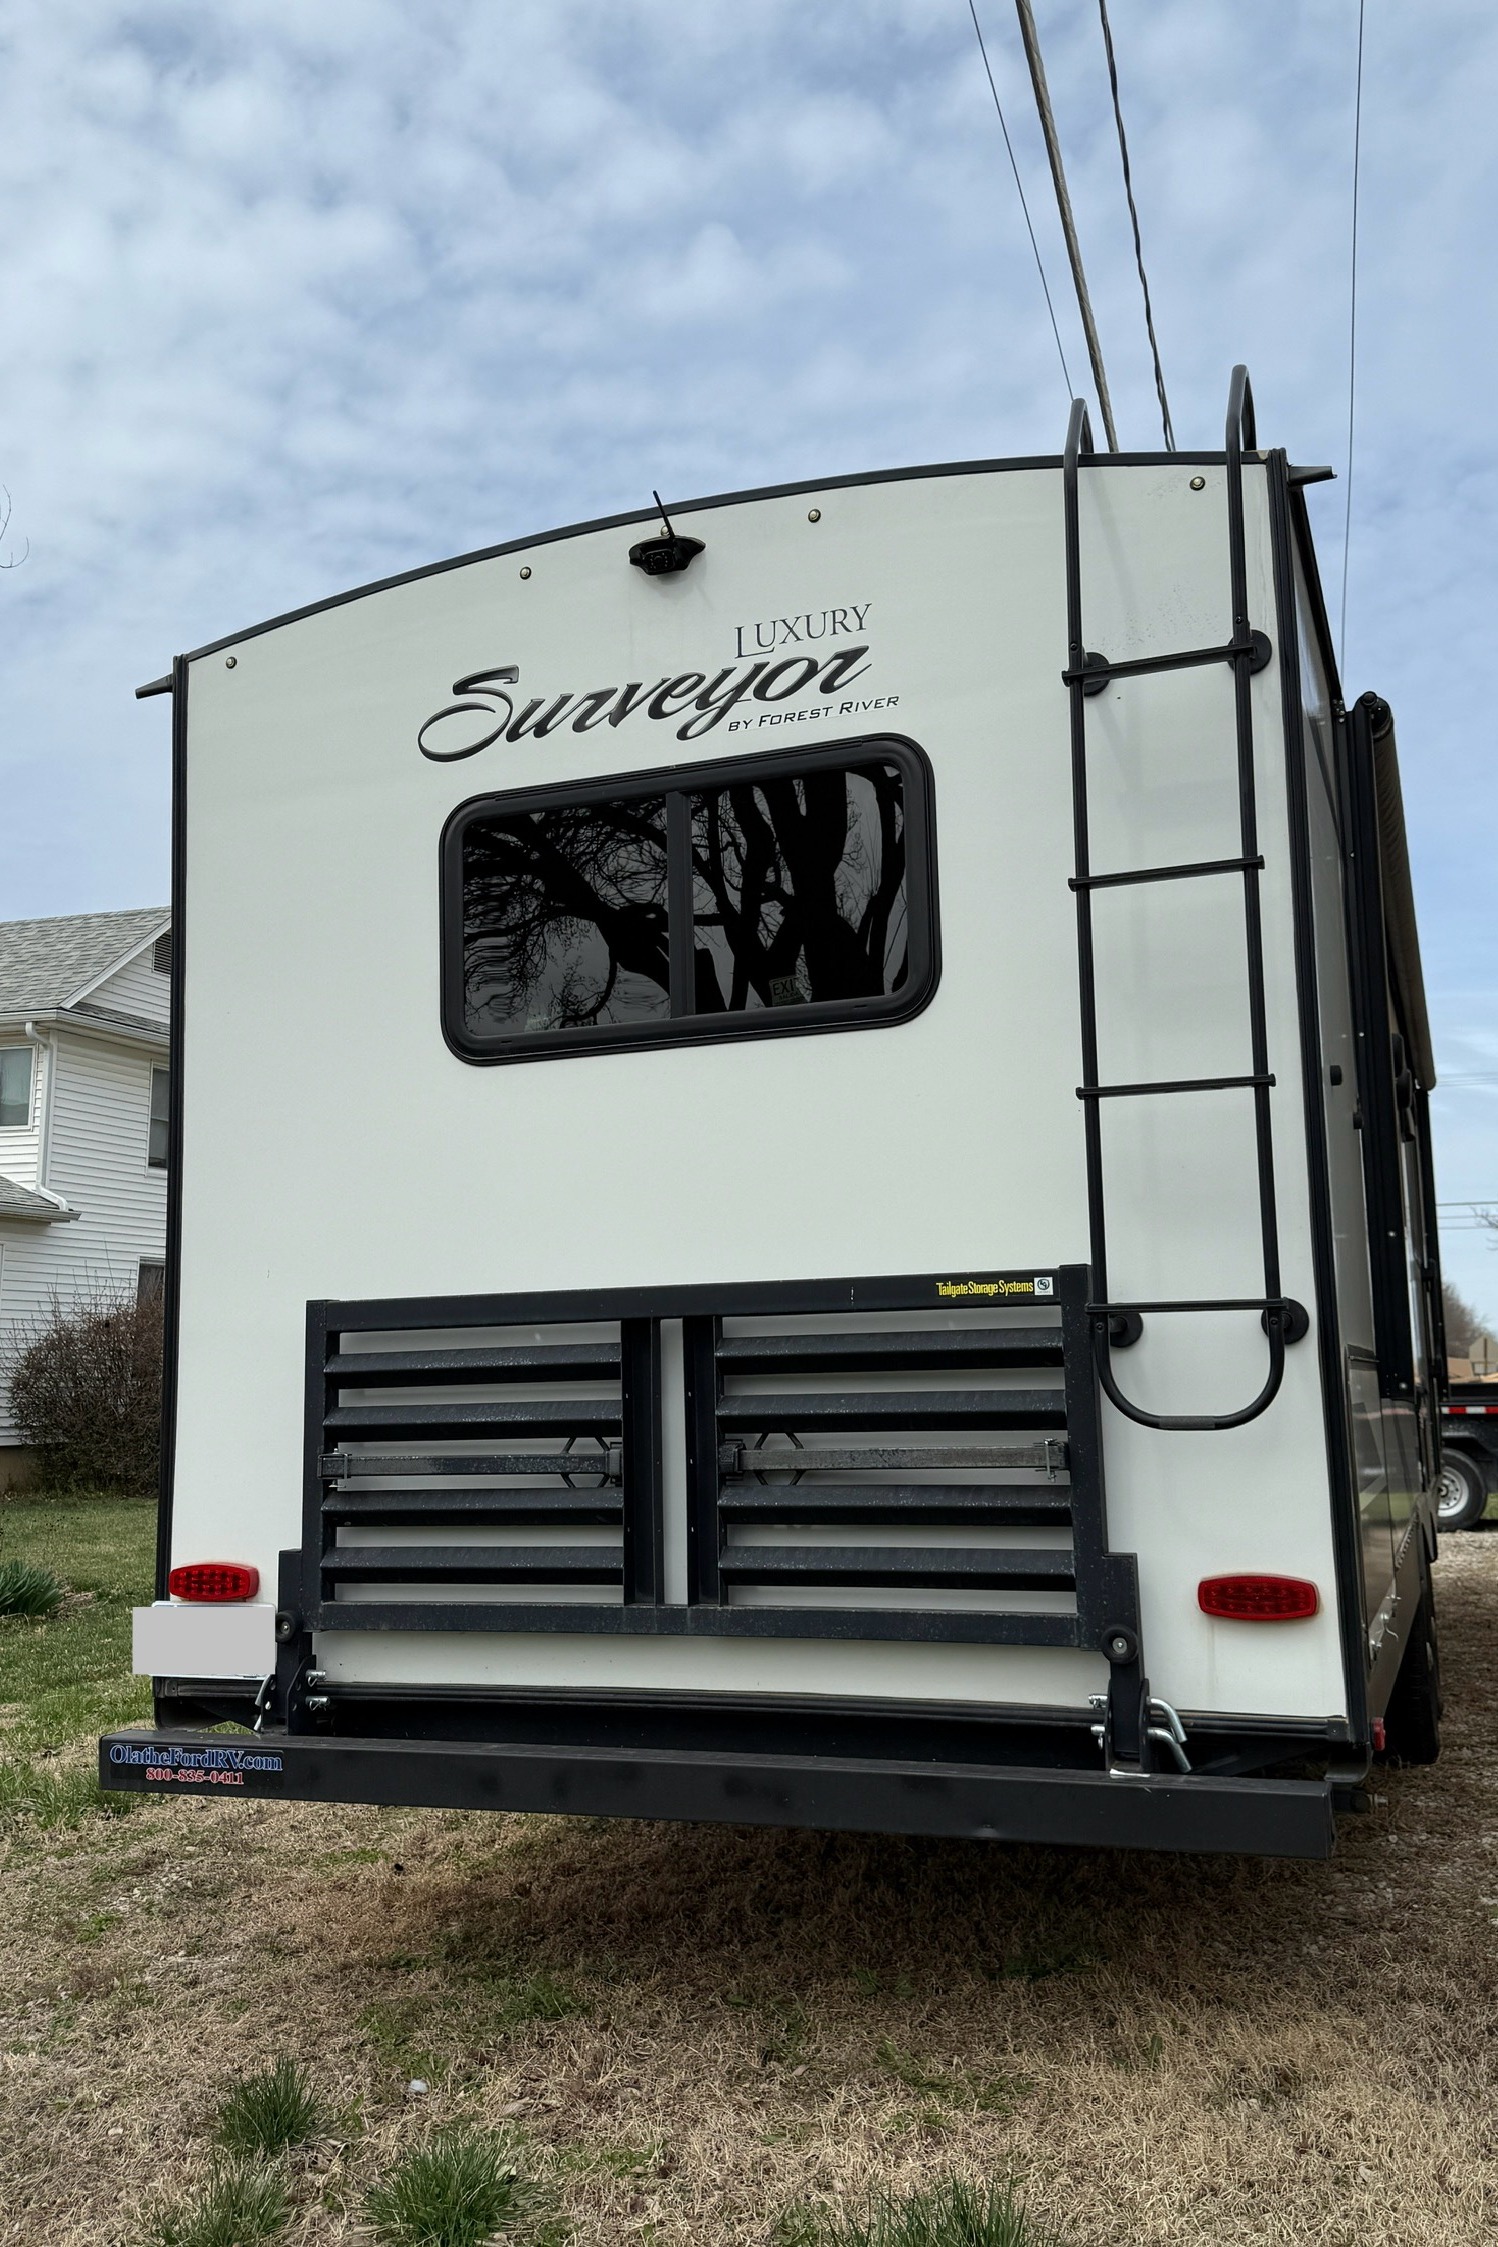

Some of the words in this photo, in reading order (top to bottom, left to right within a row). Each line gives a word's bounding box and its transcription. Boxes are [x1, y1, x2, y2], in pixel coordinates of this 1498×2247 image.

[734, 603, 872, 659] LUXURY
[418, 645, 872, 762] Surveyor
[728, 719, 753, 732] BY
[758, 706, 833, 727] FOREST
[839, 696, 899, 715] RIVER
[936, 1281, 968, 1297] Tailgate
[968, 1281, 998, 1296] Storage
[998, 1280, 1033, 1296] Systems
[110, 1744, 283, 1771] OlatheFordRV.com
[146, 1768, 244, 1785] 800-835-0411
